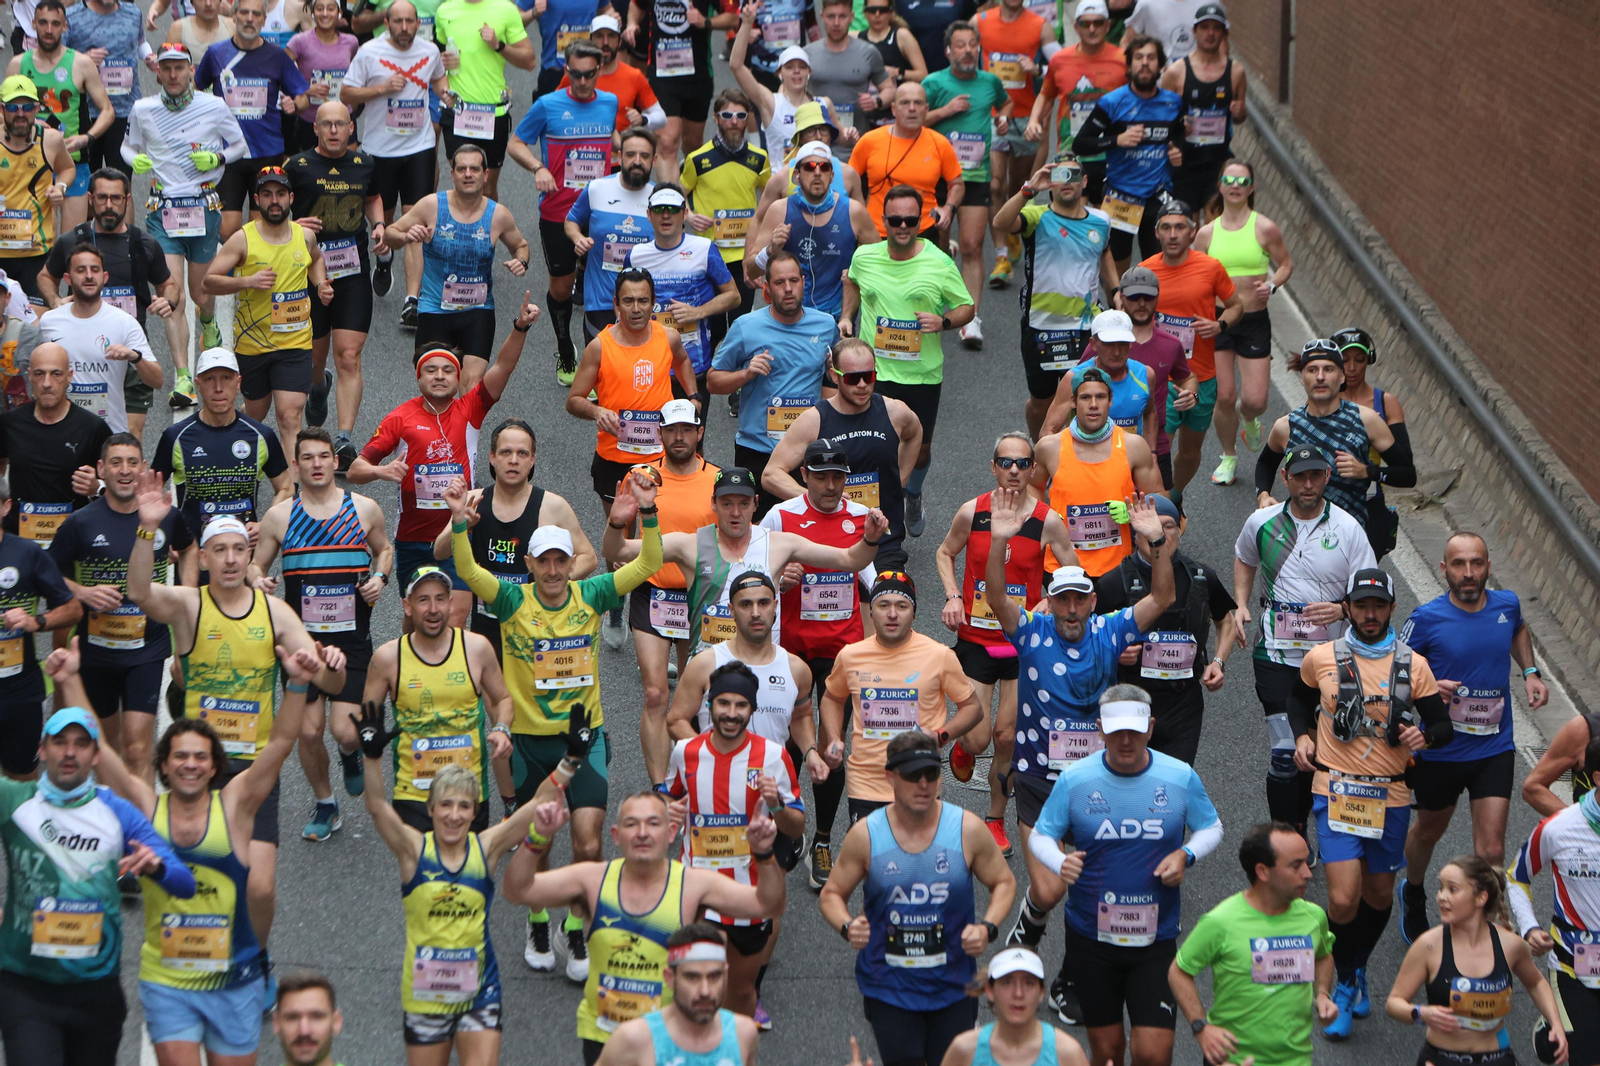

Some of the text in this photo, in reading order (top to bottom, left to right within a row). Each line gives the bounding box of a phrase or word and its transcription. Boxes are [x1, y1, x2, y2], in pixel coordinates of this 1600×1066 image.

[564, 125, 611, 136] CREDUS
[580, 151, 604, 160] ZURICH
[578, 164, 595, 173] 7193
[324, 183, 350, 191] MADRID
[728, 209, 753, 218] ZURICH
[619, 234, 645, 243] ZURICH
[329, 239, 352, 250] ZURICH
[329, 253, 346, 262] 6655
[286, 290, 307, 300] ZURICH
[458, 287, 474, 296] 6677
[286, 305, 301, 314] 4004
[286, 315, 301, 323] VASCO
[1166, 316, 1193, 327] ZURICH
[891, 320, 918, 330] ZURICH
[885, 343, 910, 352] EDUARDO
[75, 384, 103, 393] ZURICH
[785, 398, 812, 407] ZURICH
[633, 426, 651, 435] 6676
[848, 430, 872, 439] EATON
[627, 437, 656, 445] FERNANDO
[431, 465, 460, 474] ZURICH
[218, 475, 253, 484] TAFALLA
[430, 480, 449, 489] 7942
[846, 475, 873, 484] ZURICH
[36, 504, 68, 514] ZURICH
[219, 501, 248, 512] ZURICH
[1084, 520, 1103, 530] 6811
[1084, 532, 1107, 541] POYATO
[821, 574, 850, 583] ZURICH
[319, 586, 349, 596] ZURICH
[819, 590, 838, 599] 6542
[319, 602, 338, 611] 7321
[818, 602, 839, 611] RAFITA
[666, 607, 685, 617] 7512
[663, 619, 687, 628] JUANLU
[717, 623, 737, 634] 5663
[1162, 632, 1194, 642] ZURICH
[1293, 631, 1309, 640] ERIC
[553, 637, 585, 650] ZURICH
[1161, 649, 1180, 659] 7441
[553, 655, 574, 666] 4016
[1157, 661, 1183, 670] VINCENT
[555, 669, 574, 677] NENE
[880, 690, 912, 699] ZURICH
[1472, 688, 1501, 698] ZURICH
[218, 700, 255, 712] ZURICH
[1468, 703, 1489, 713] 6435
[879, 707, 900, 717] 7936
[863, 718, 917, 729] SÉRGIO MOREIRA
[1464, 715, 1490, 725] ANDRES
[431, 737, 466, 748] ZURICH
[1068, 738, 1089, 748] 7110
[432, 755, 454, 766] 4018
[1065, 751, 1090, 760] CARLOS
[416, 769, 437, 779] DAVID
[1347, 785, 1381, 797] ZURICH
[1345, 802, 1366, 814] 5543
[707, 816, 742, 827] ZURICH
[1094, 818, 1165, 841] ADS
[708, 834, 729, 845] 3639
[705, 848, 735, 857] SERAPIO
[888, 882, 951, 905] ADS
[1119, 894, 1154, 904] ZURICH
[903, 914, 938, 926] ZURICH
[1118, 911, 1141, 923] 7883
[1110, 925, 1148, 935] ESTALRICH
[902, 932, 926, 944] 2740
[1271, 937, 1305, 949] ZURICH
[436, 950, 471, 961] ZURICH
[1266, 972, 1302, 983] CARLITOS
[617, 982, 656, 995] ZURICH
